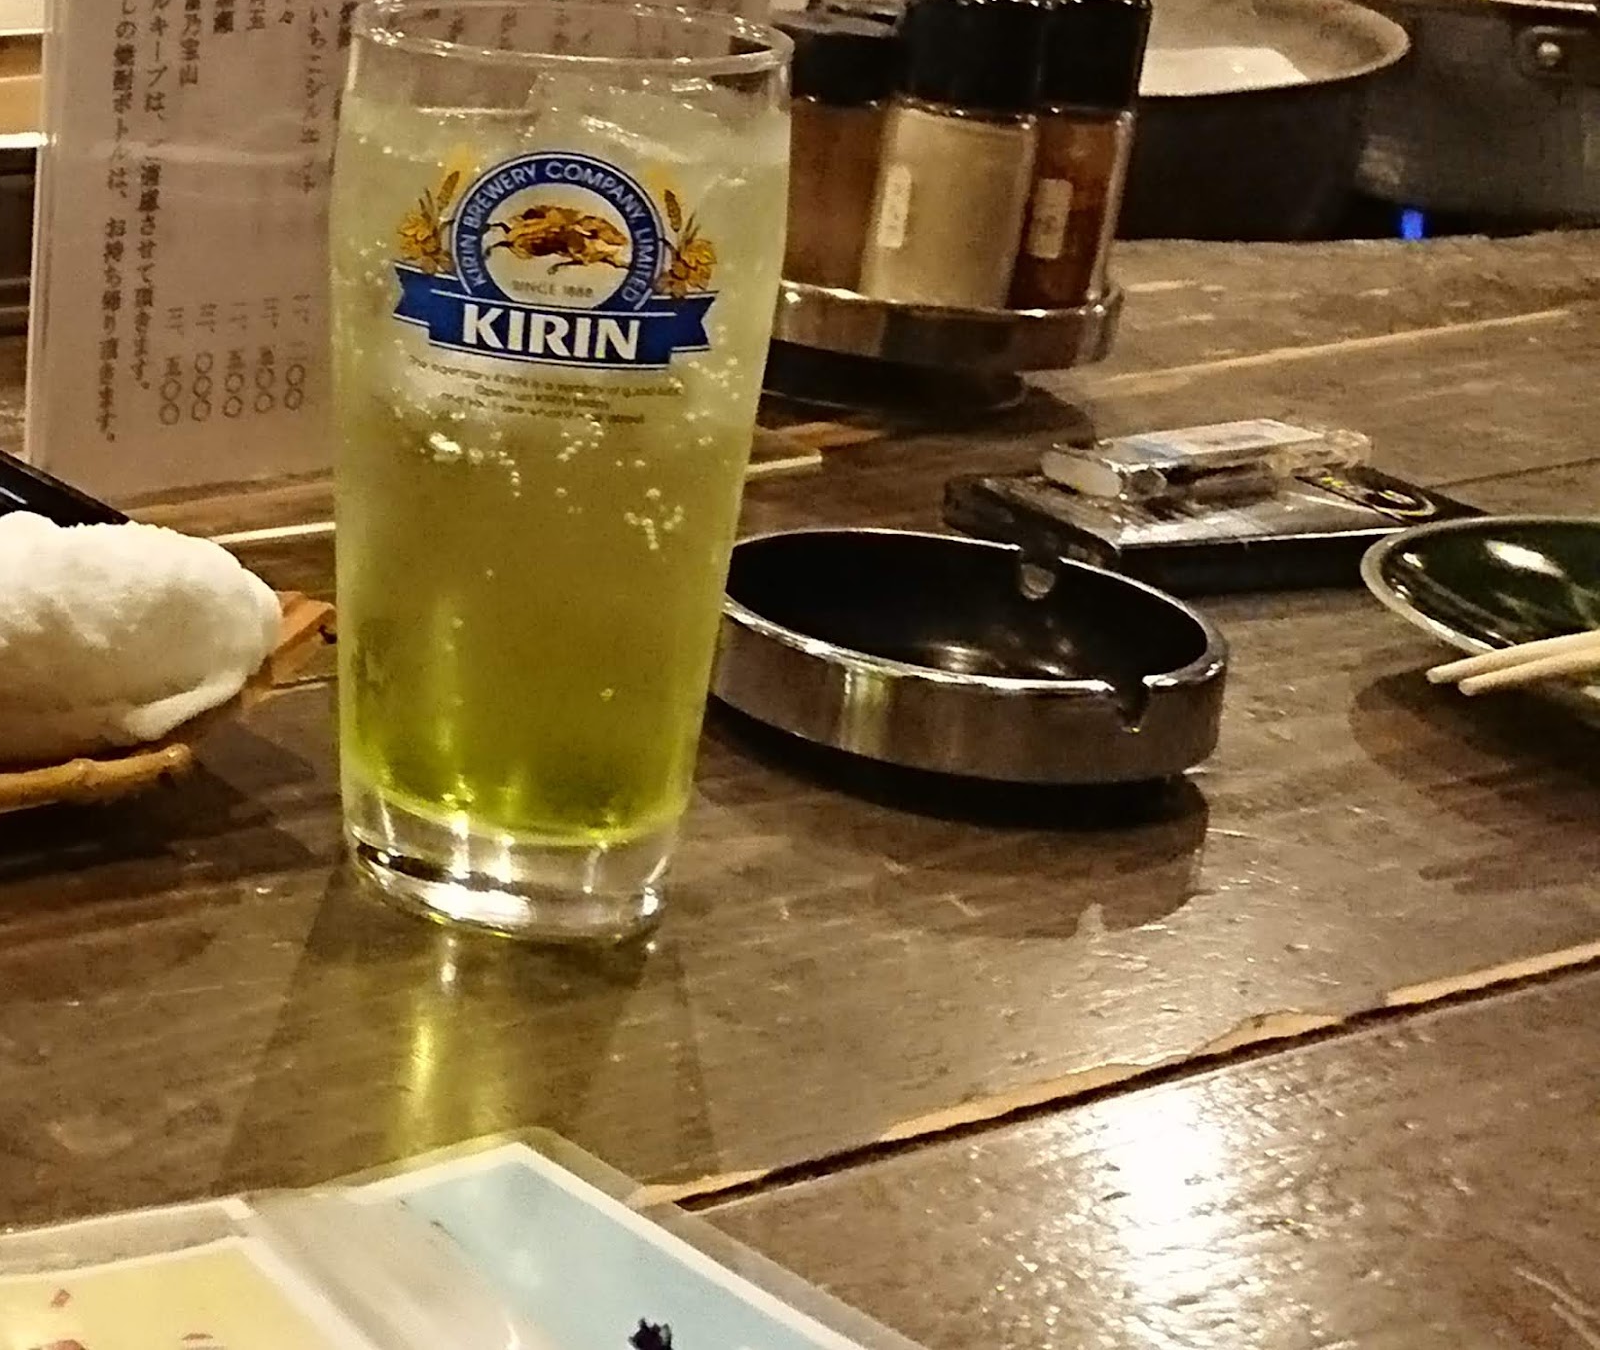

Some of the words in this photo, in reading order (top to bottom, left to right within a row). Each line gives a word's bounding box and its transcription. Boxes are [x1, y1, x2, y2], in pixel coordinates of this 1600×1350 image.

[463, 162, 538, 228] BREWERY
[459, 234, 488, 287] KIRIN
[511, 279, 556, 297] SINCE
[621, 226, 655, 303] LIMITED
[462, 302, 641, 361] KIRIN
